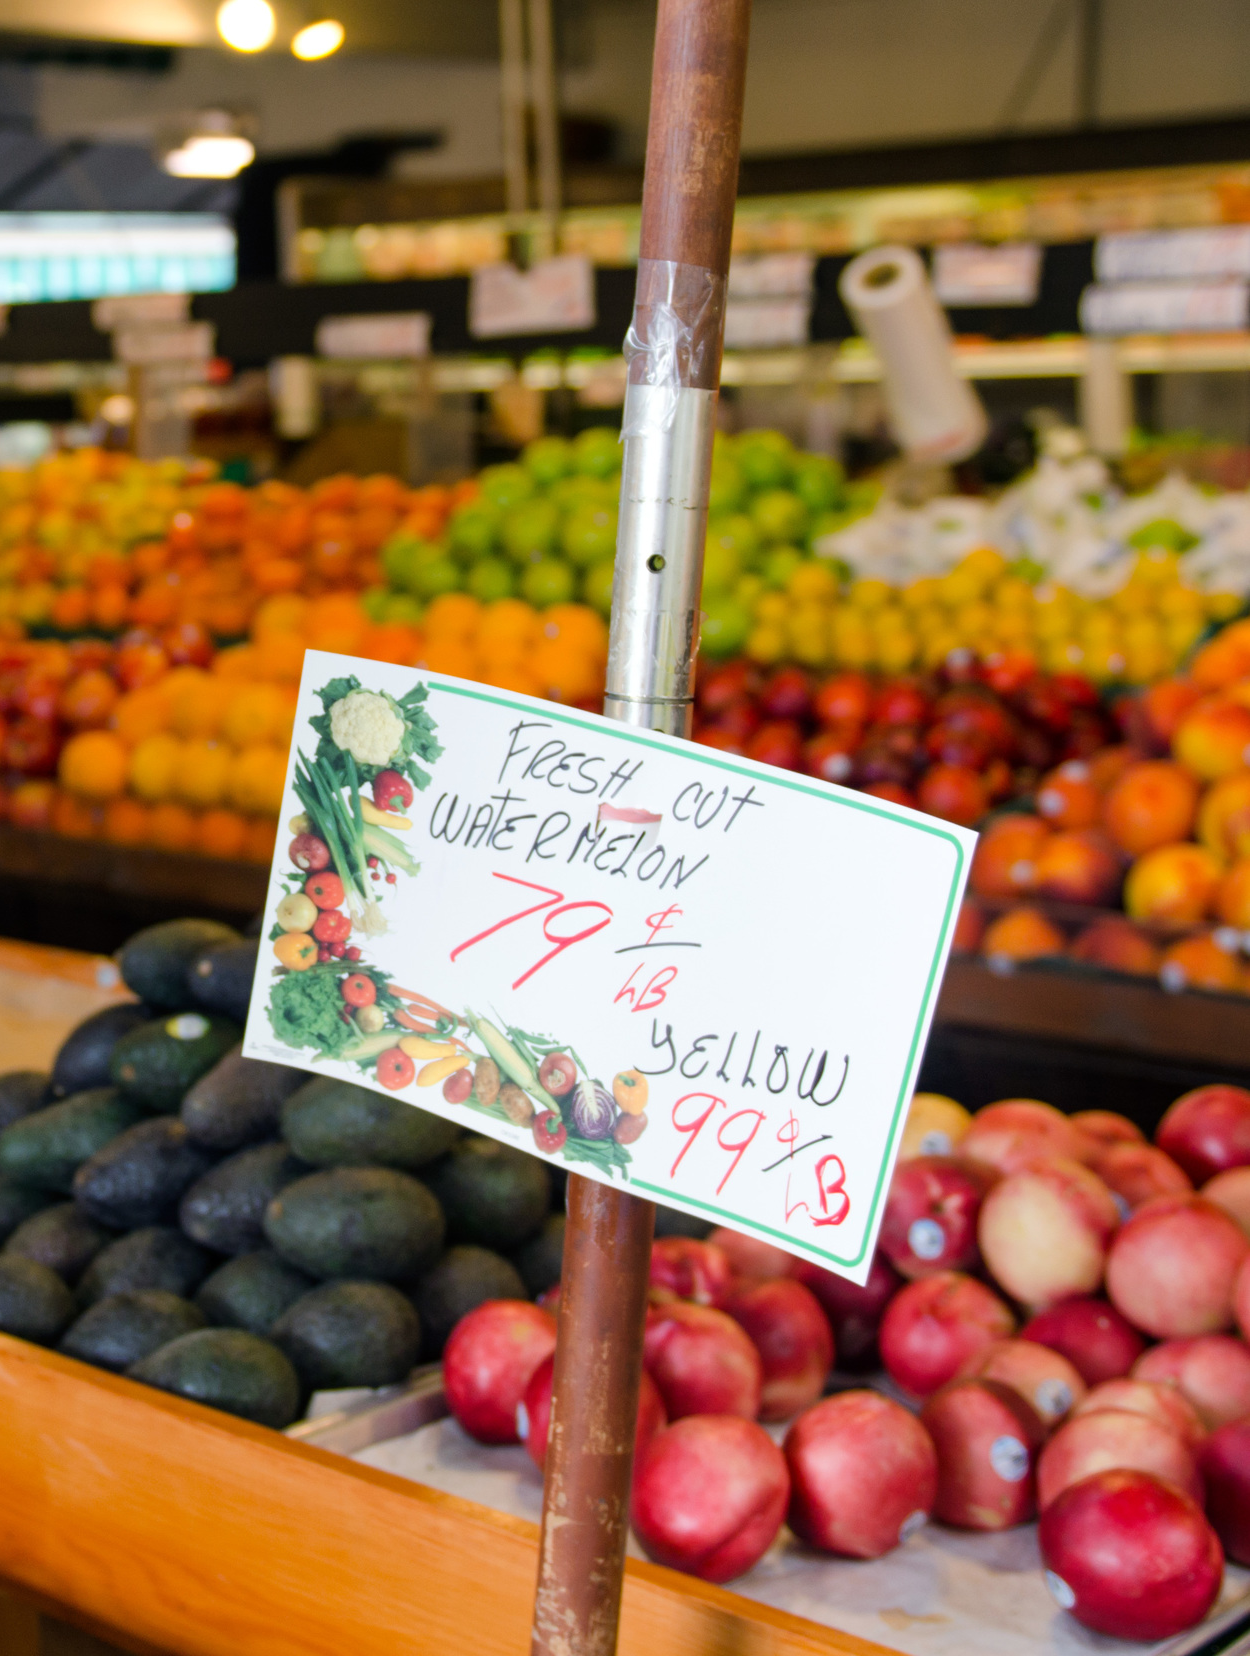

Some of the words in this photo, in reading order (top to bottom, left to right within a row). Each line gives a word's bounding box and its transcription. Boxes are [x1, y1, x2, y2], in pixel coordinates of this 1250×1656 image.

[498, 720, 644, 799] FRESH
[672, 782, 766, 832] CUT
[429, 788, 710, 890] WATERMELON
[633, 1017, 850, 1107] YELLOW
